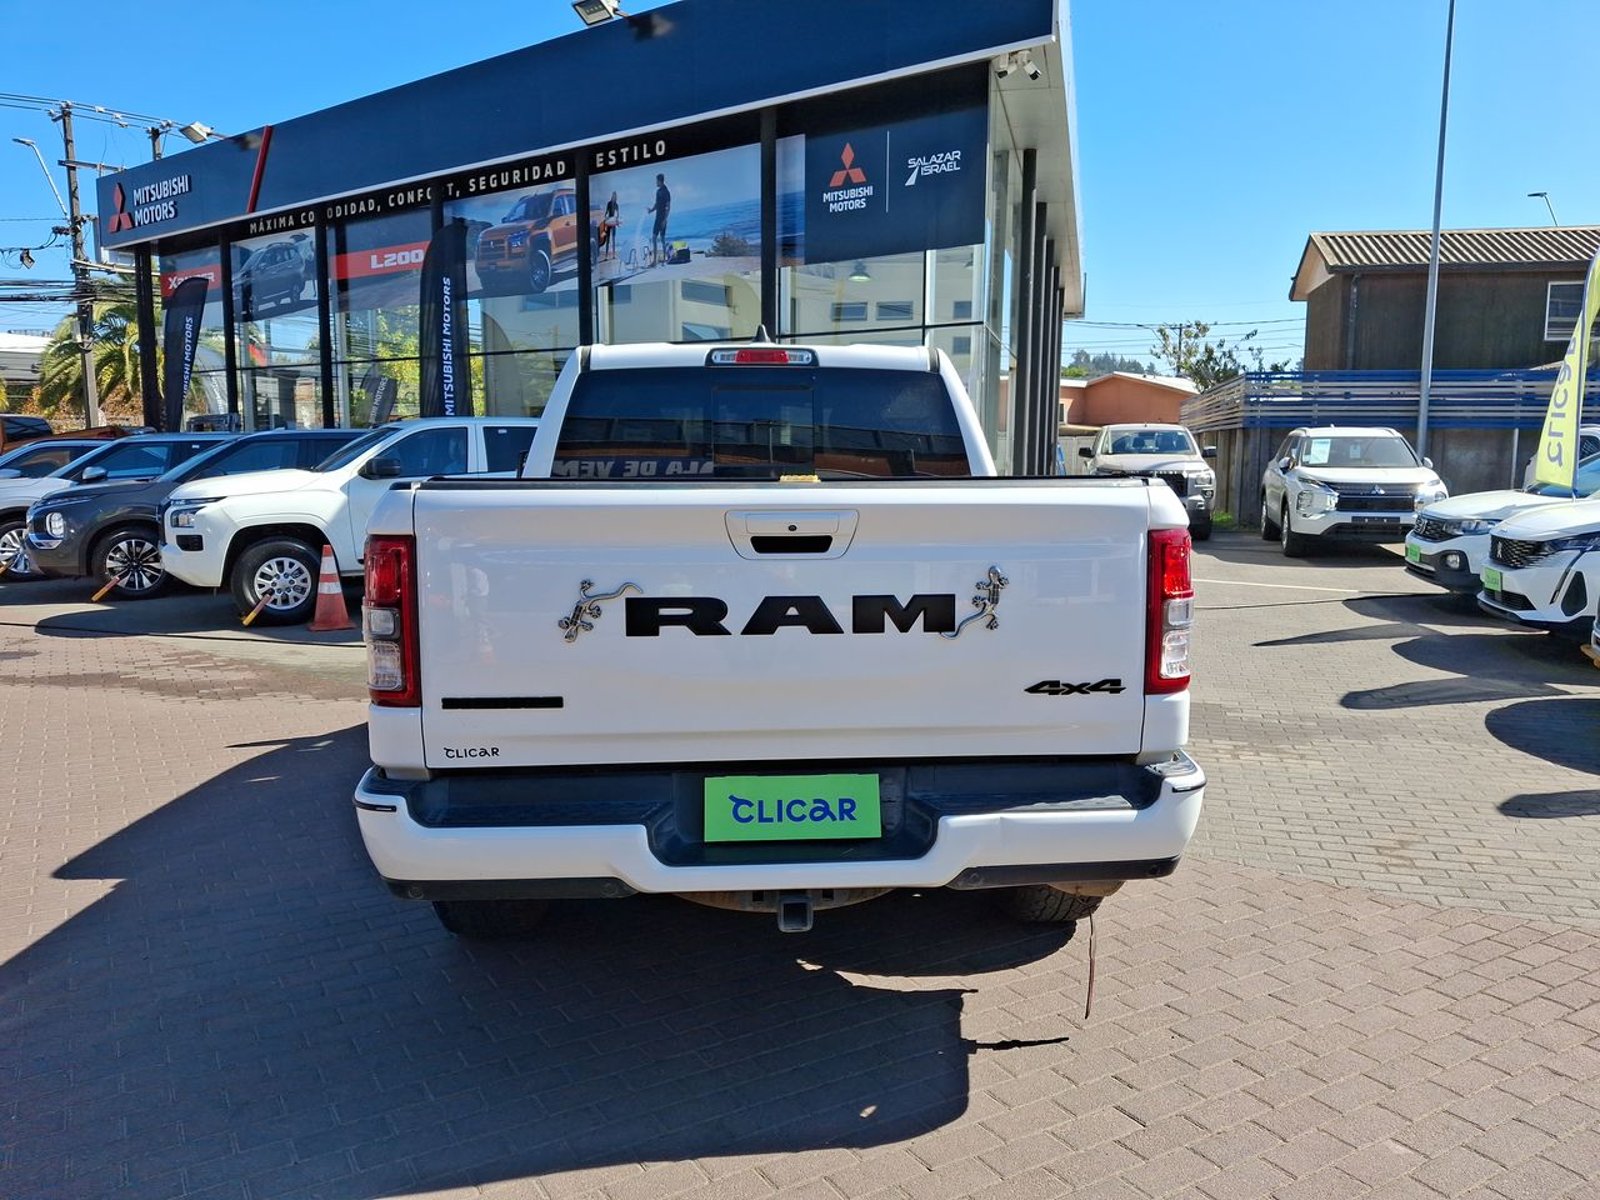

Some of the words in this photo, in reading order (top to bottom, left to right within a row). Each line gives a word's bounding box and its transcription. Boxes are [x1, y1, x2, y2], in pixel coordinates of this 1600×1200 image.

[907, 150, 962, 168] SALAZAR
[920, 161, 961, 176] ISRAEL
[133, 174, 190, 206] MITSUBISHI
[249, 214, 295, 234] MÁXIMA
[300, 199, 381, 224] COODIDAD,
[468, 160, 567, 193] SEGURIDAD
[595, 140, 667, 168] ESTILO
[823, 185, 874, 203] MITSUBISHI
[134, 201, 177, 227] MOTORS
[829, 198, 867, 213] MOTORS
[370, 249, 425, 269] L200
[442, 277, 451, 336] MOTORS
[184, 316, 194, 361] MOTORS
[442, 338, 456, 417] MITSUBISHI
[625, 593, 956, 637] RAM
[1024, 678, 1127, 695] 4x4
